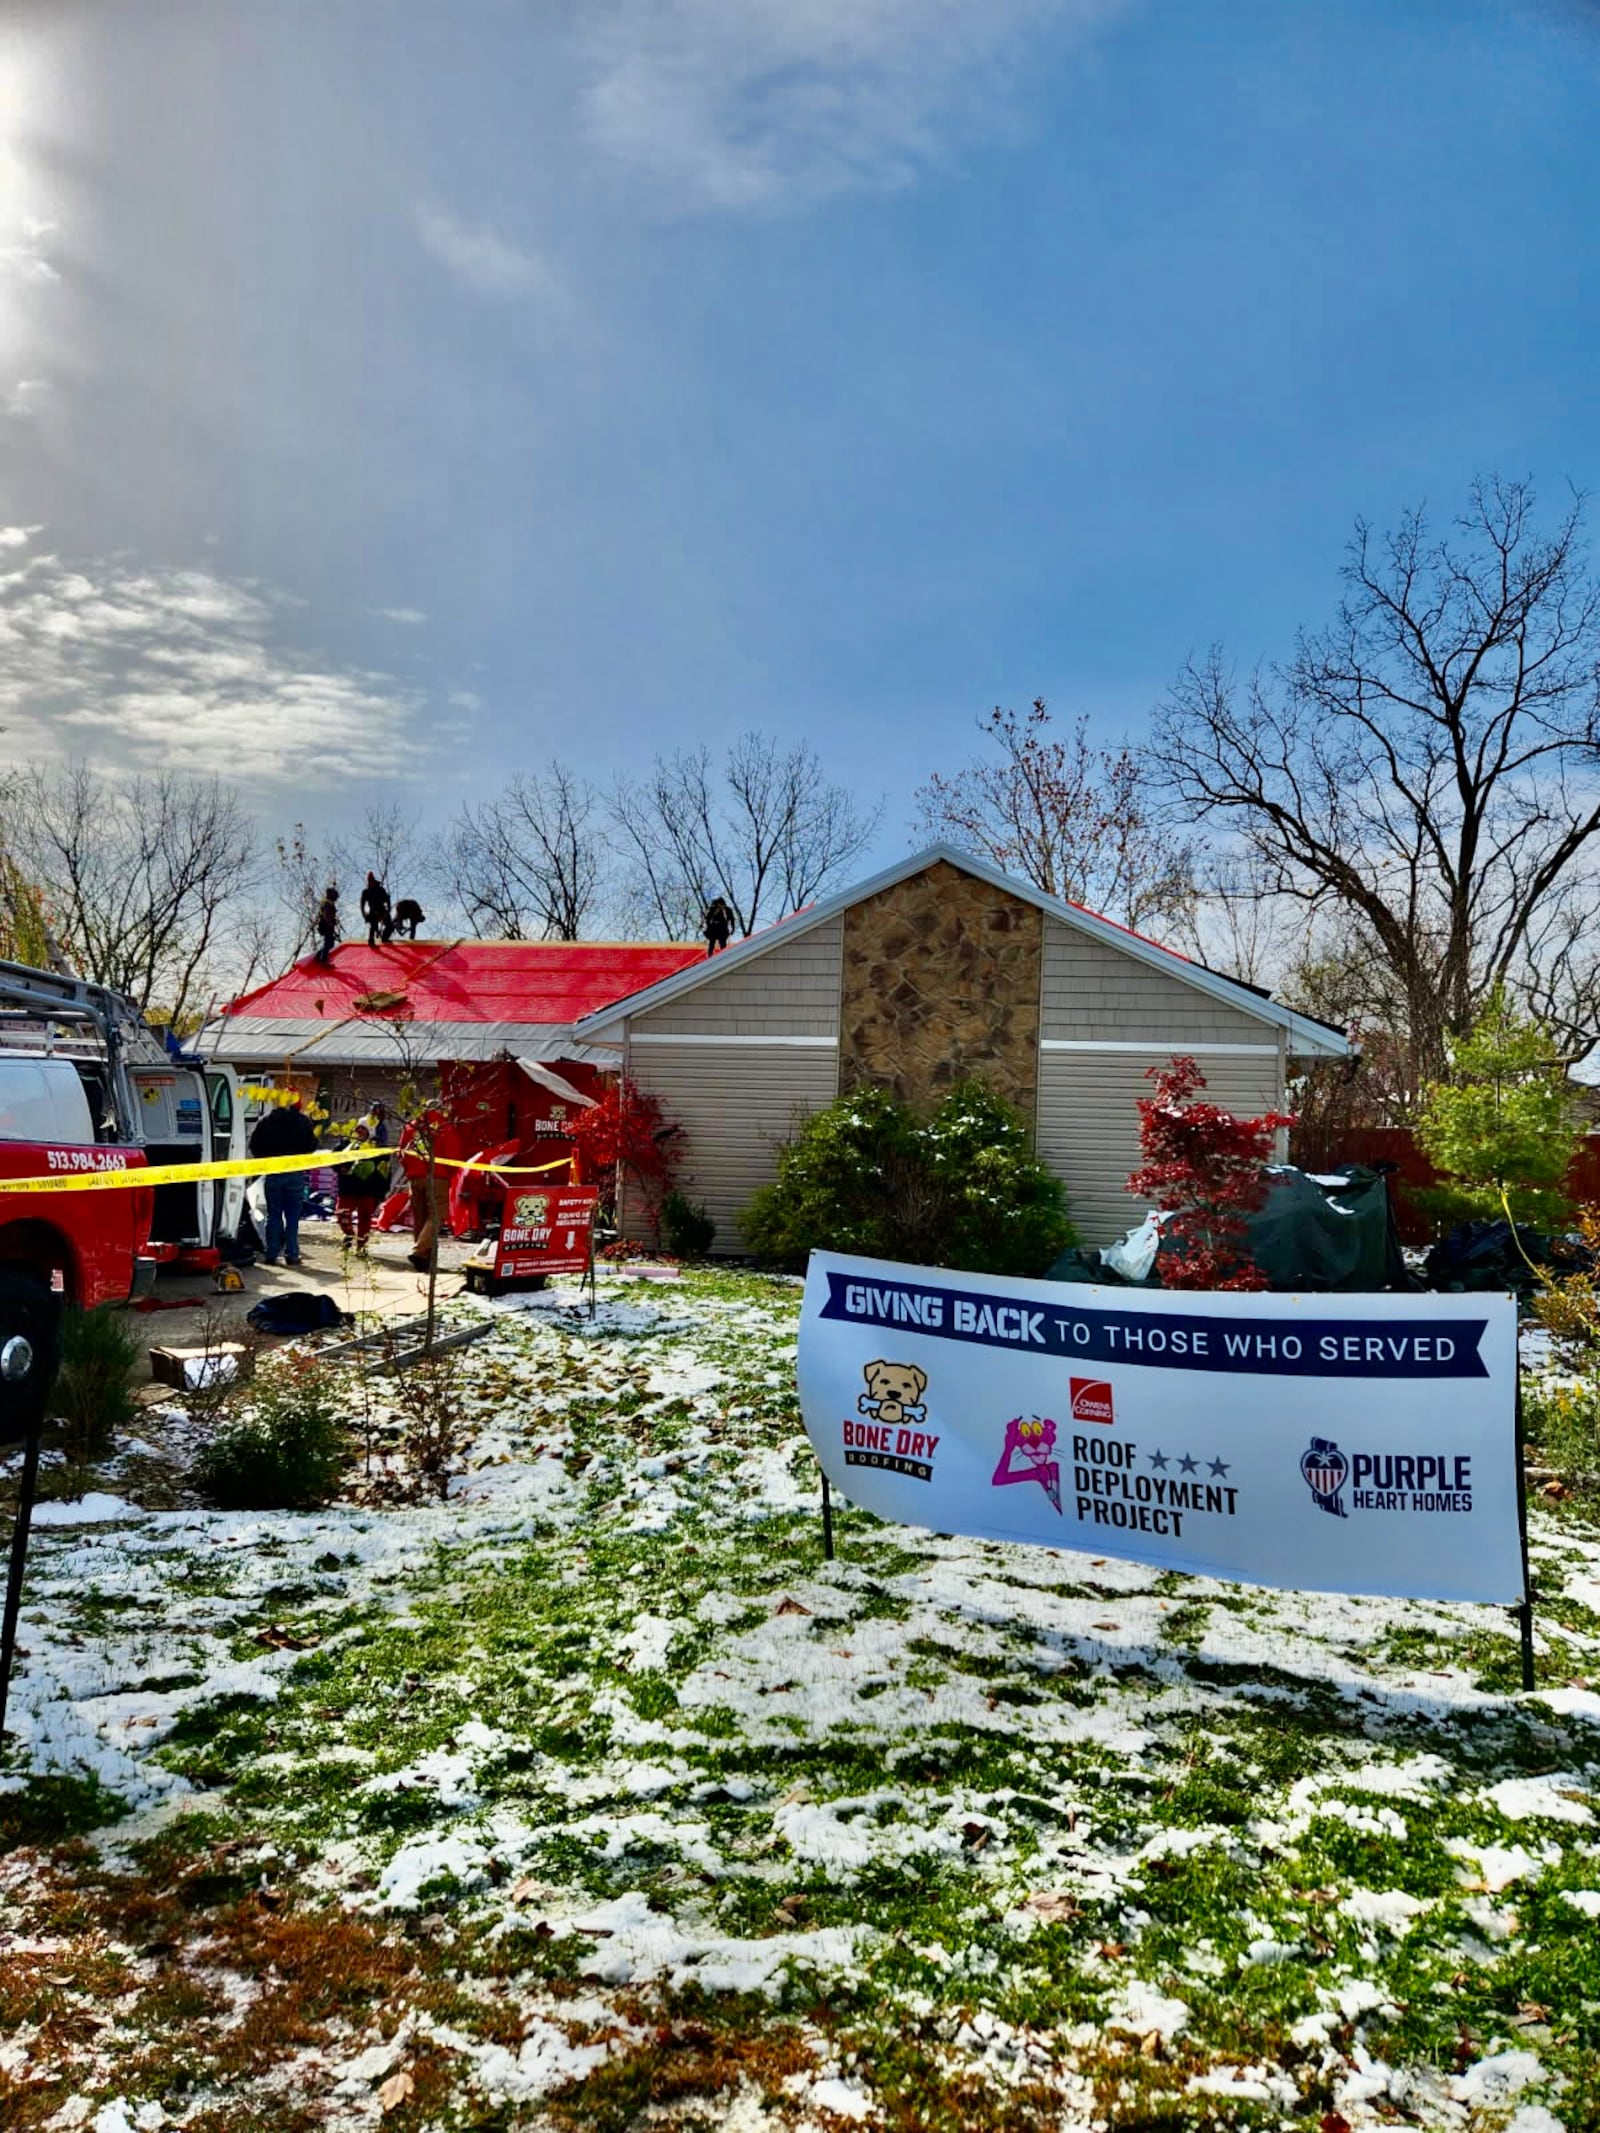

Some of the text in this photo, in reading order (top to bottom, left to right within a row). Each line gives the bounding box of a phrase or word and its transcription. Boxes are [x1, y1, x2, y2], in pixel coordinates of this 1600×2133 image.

[535, 1119, 559, 1131] BONE
[47, 1151, 127, 1170] 513.984.2663
[503, 1227, 552, 1242] BONE DRY
[845, 1284, 1455, 1361] GIVING BACK TO THOSE WHO SERVED
[1075, 1405, 1111, 1419] CORNING
[844, 1420, 940, 1459] BONE DRY
[1073, 1435, 1136, 1469] ROOF
[848, 1454, 927, 1477] ROOFING
[1352, 1454, 1472, 1491] PURPLE
[1074, 1466, 1238, 1515] DEPLOYMENT
[1353, 1490, 1472, 1512] HEART HOMES
[1077, 1496, 1183, 1537] PROJECT
